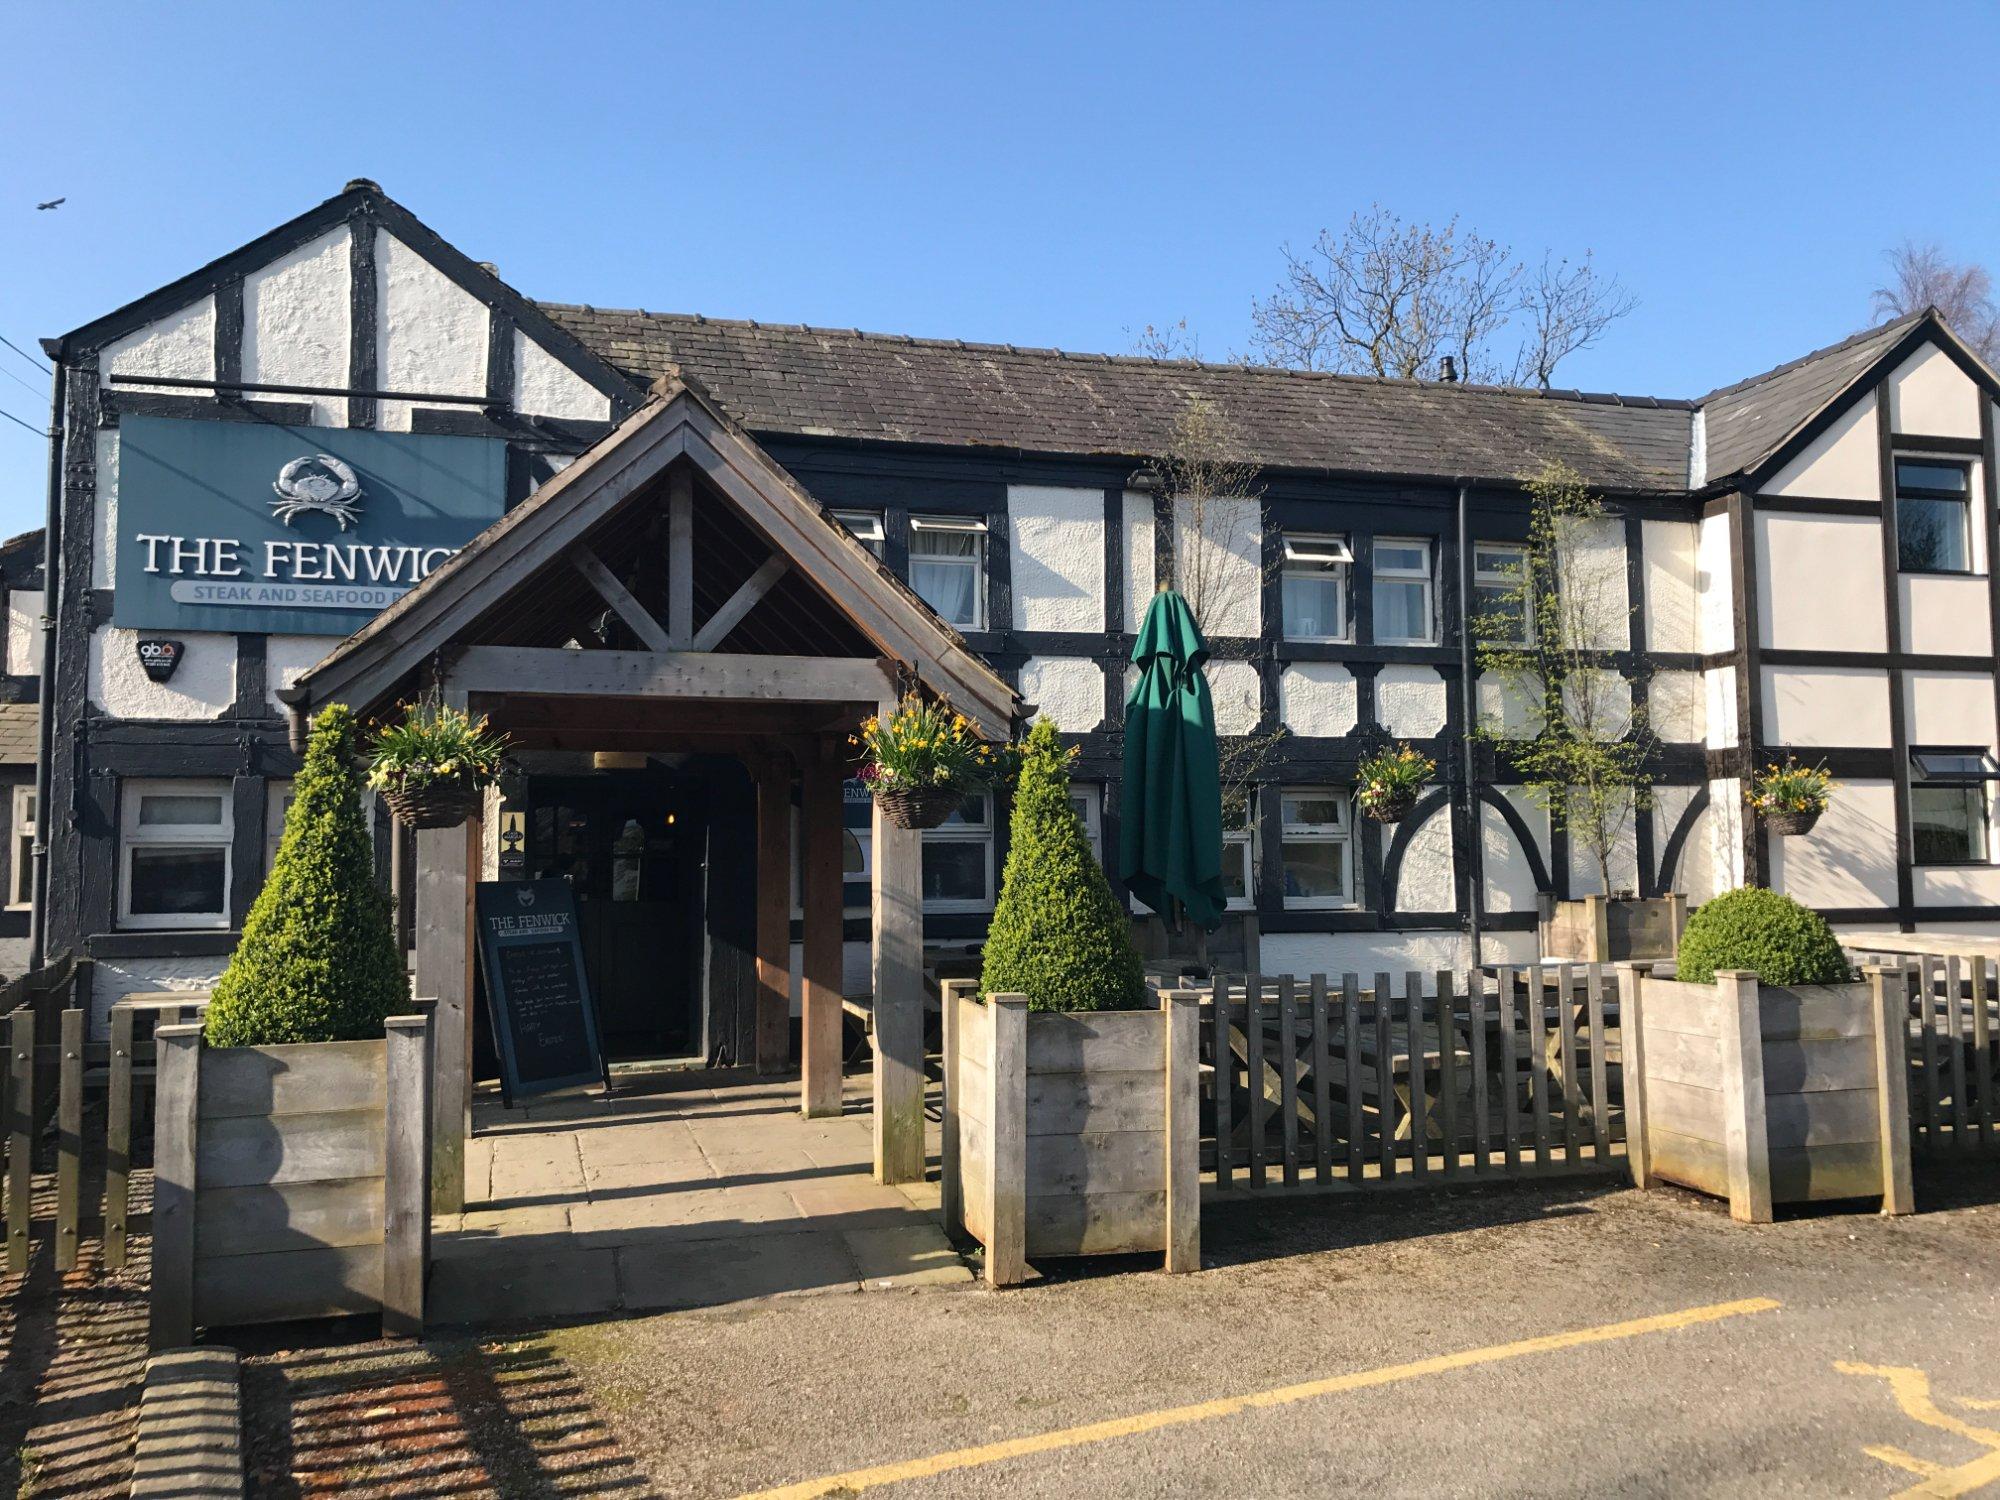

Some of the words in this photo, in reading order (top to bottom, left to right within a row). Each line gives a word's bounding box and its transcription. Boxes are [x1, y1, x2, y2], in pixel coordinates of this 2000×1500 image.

[136, 533, 242, 576] THE
[263, 541, 463, 582] FENWIC
[194, 586, 252, 600] STEAK
[258, 588, 297, 602] AND
[302, 589, 386, 604] SEAFOOD
[489, 916, 516, 930] THE
[518, 912, 570, 928] FENWICK
